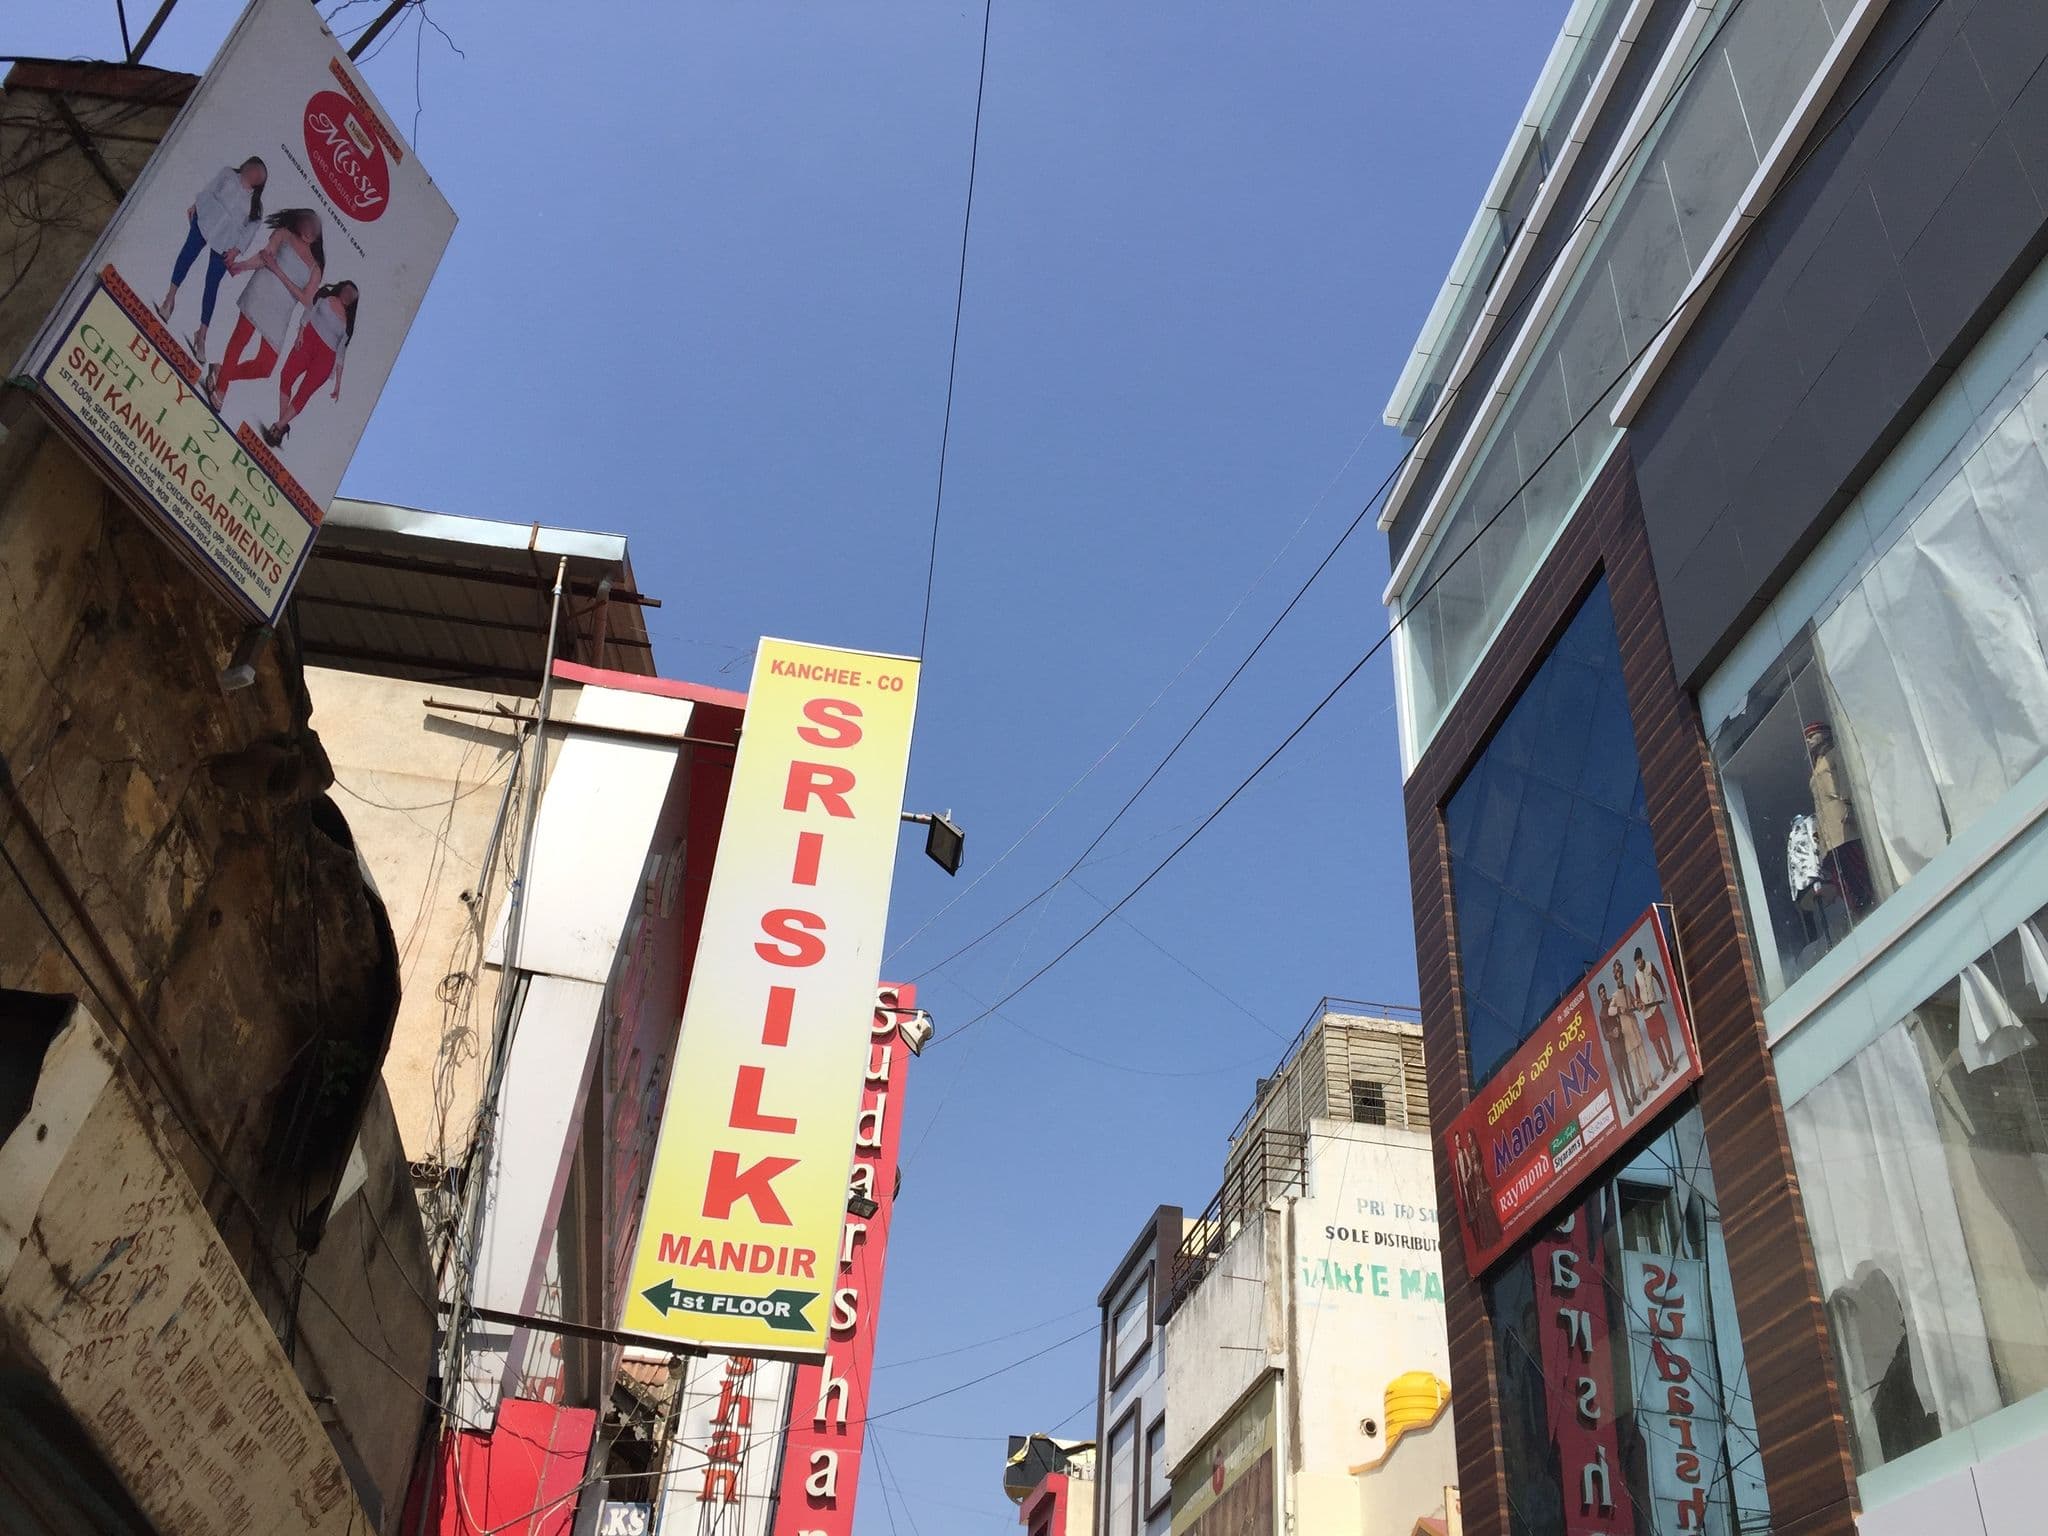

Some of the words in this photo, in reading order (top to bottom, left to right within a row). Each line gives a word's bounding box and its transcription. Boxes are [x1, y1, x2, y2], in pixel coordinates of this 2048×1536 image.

[309, 112, 383, 208] Missy
[68, 346, 104, 390] SRI
[103, 385, 187, 484] KANNIKA
[190, 479, 281, 583] GARMENTS
[79, 405, 98, 428] NEAR
[111, 439, 135, 467] TEMPLE
[79, 324, 143, 391] GET
[155, 407, 167, 425] 1
[180, 435, 219, 480] PC
[228, 487, 293, 564] FREE
[128, 333, 193, 404] BUY
[202, 418, 220, 443] 2
[231, 448, 278, 507] PCS
[770, 659, 861, 687] KANCHEE
[878, 675, 904, 692] CO
[783, 698, 863, 886] SRI
[701, 908, 828, 1227] SILK
[1493, 1090, 1556, 1177] Manav
[1559, 1041, 1600, 1109] NX
[657, 1233, 817, 1278] MANDIR
[798, 986, 899, 1536] Sudarsha
[1325, 1225, 1369, 1244] SOLE
[669, 1290, 705, 1311] 1st
[711, 1296, 791, 1318] FLOOR
